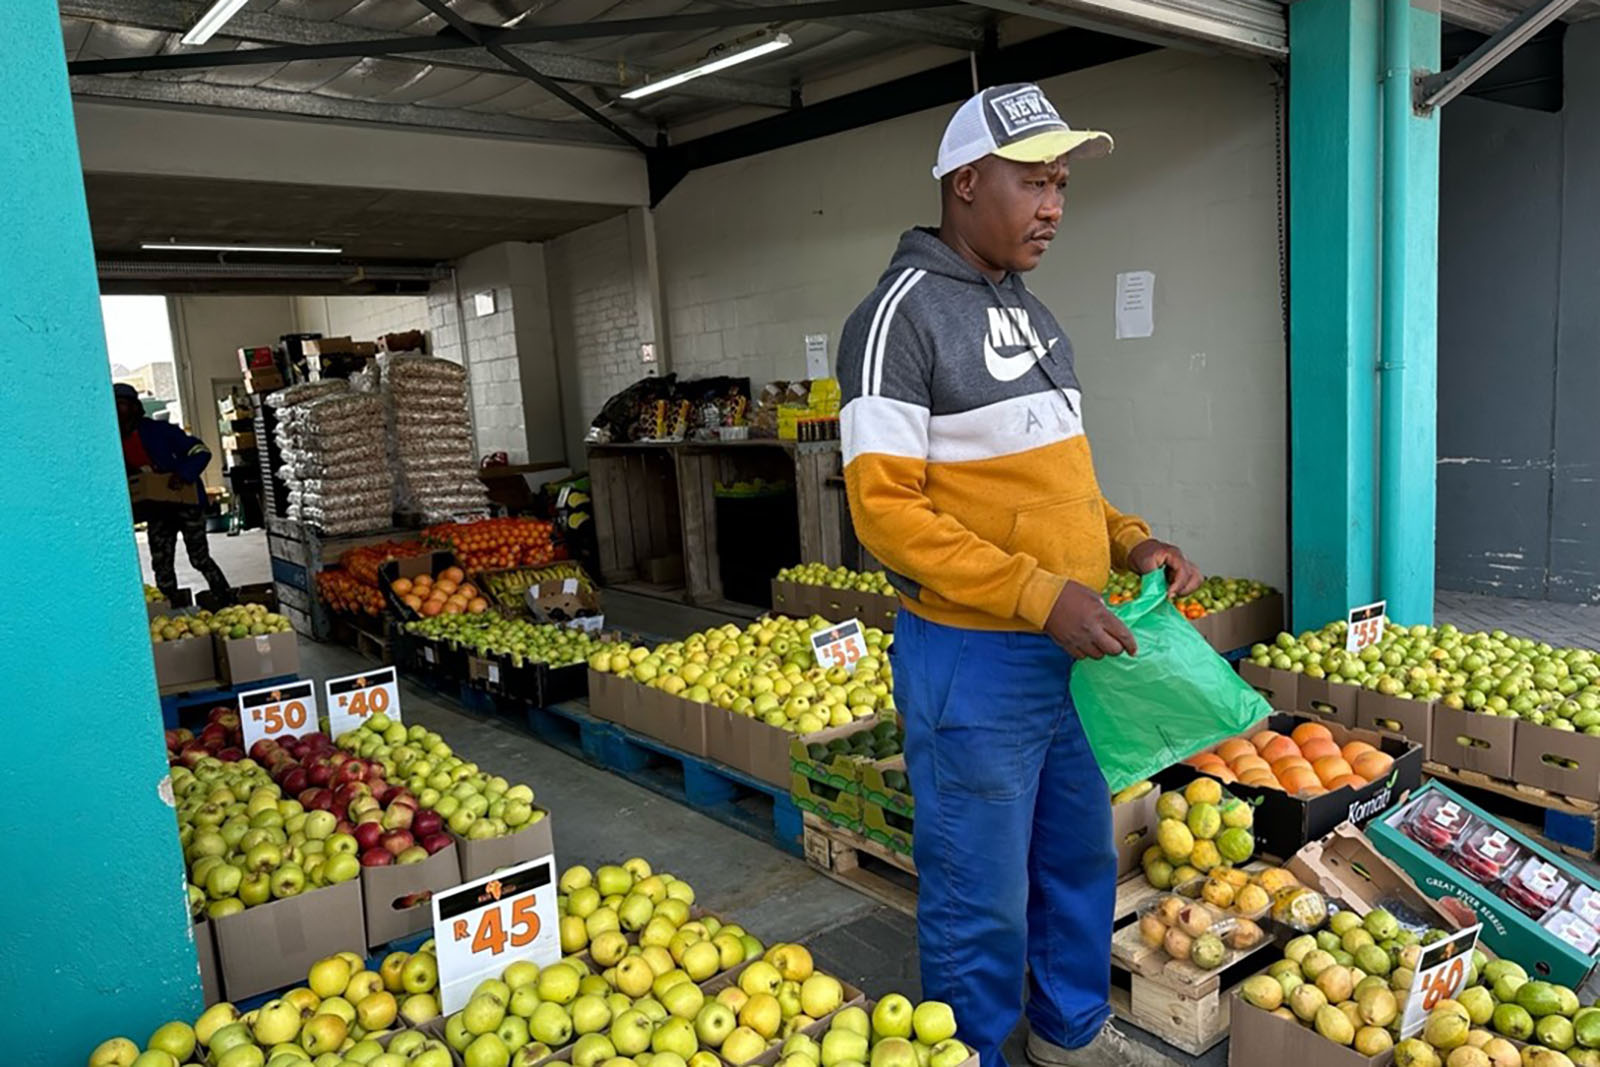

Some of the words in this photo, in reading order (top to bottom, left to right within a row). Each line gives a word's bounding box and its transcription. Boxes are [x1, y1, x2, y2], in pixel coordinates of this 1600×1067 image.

[1001, 92, 1042, 121] NEW
[252, 701, 307, 734] R50
[338, 686, 389, 717] R40
[1348, 788, 1391, 824] Komati
[1425, 876, 1455, 893] GREAT
[1456, 888, 1481, 909] RIVER
[1480, 905, 1508, 936] BERRIES
[453, 894, 541, 956] R45
